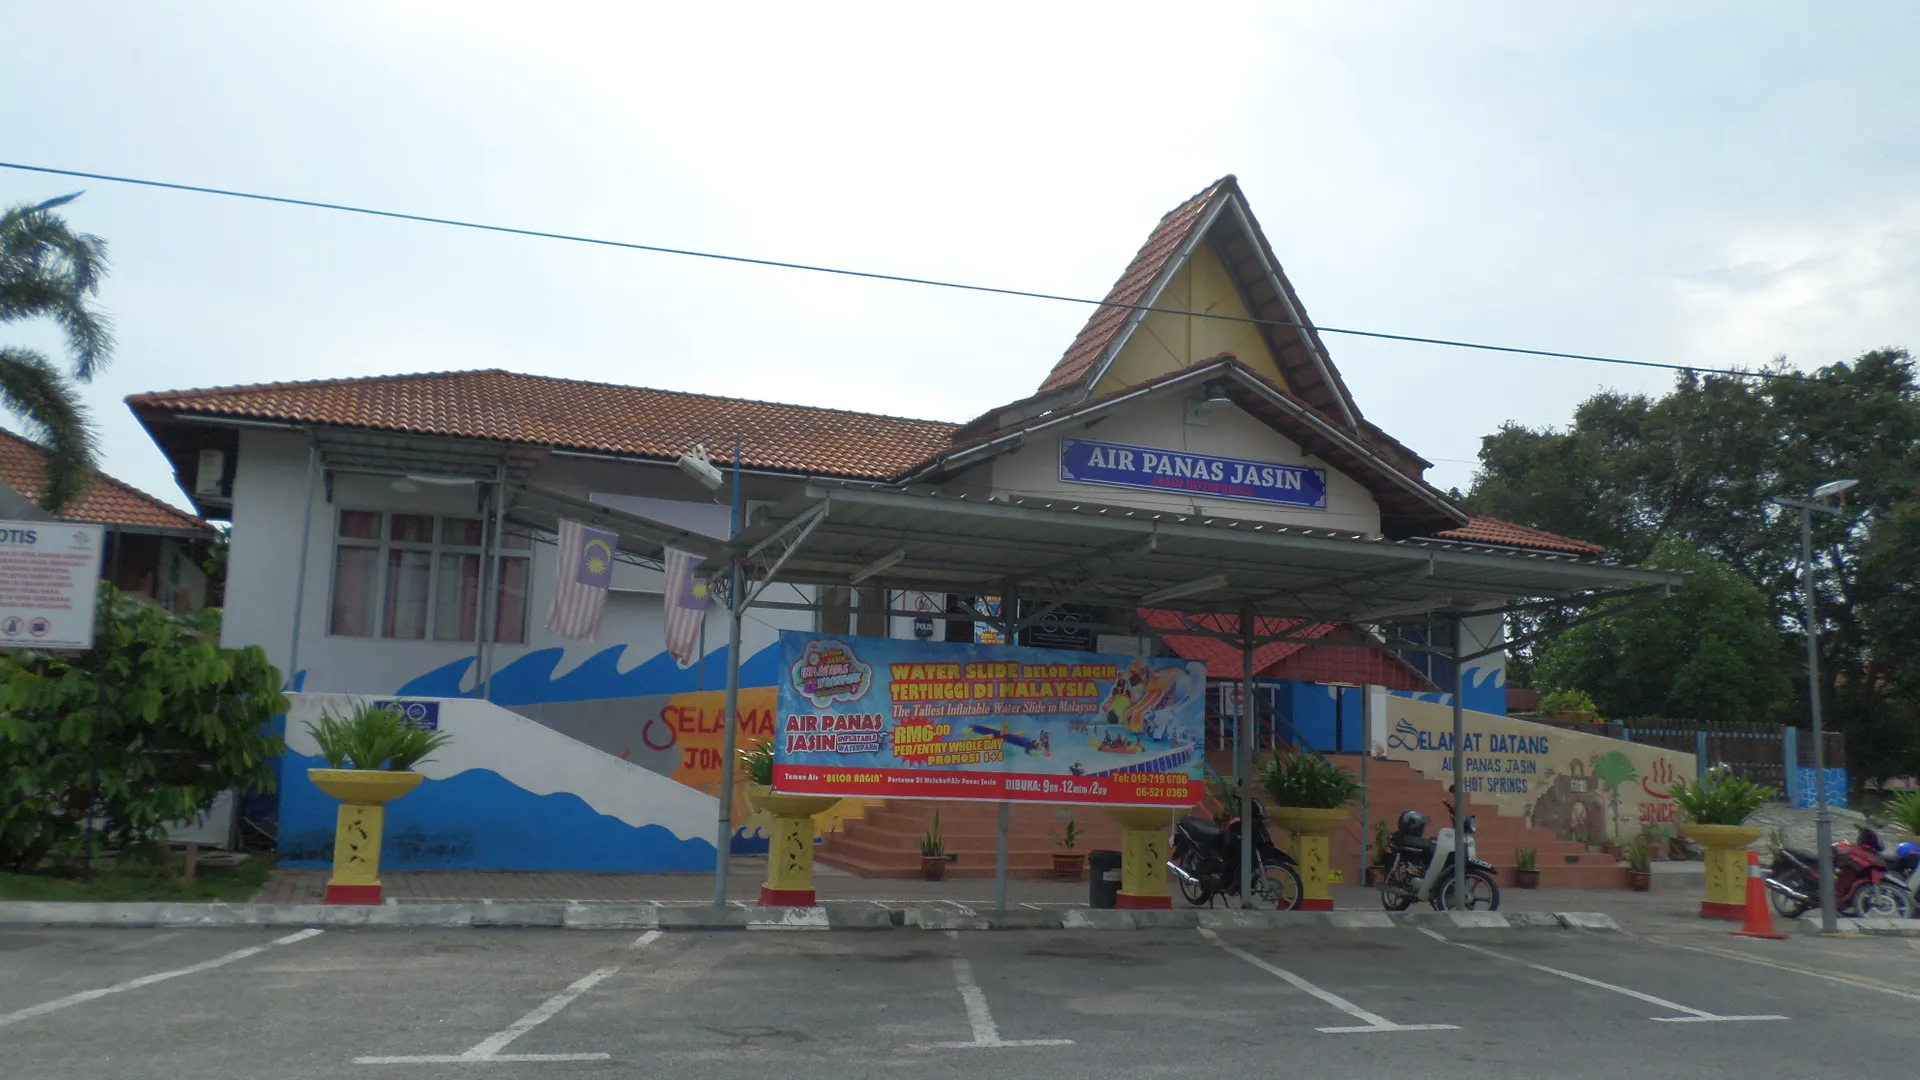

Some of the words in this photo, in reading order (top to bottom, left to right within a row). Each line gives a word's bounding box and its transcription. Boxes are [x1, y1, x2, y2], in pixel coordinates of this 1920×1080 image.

[1088, 447, 1135, 471] AIR
[1142, 453, 1224, 481] PANAS
[1230, 464, 1302, 490] JASIN
[916, 622, 932, 631] POLIS
[892, 665, 961, 680] WATER
[966, 664, 1019, 679] SLIDE
[1024, 666, 1068, 678] BELON
[1071, 665, 1116, 678] ANGIN
[891, 683, 969, 700] TERTINGGI
[974, 683, 994, 698] DI
[1000, 682, 1098, 698] MALAYSIA
[892, 704, 910, 717] The
[914, 704, 944, 716] Tallest
[947, 702, 990, 715] Inflatable
[994, 702, 1020, 714] Water
[1023, 701, 1046, 714] Slide
[1048, 702, 1057, 712] in
[1059, 700, 1098, 714] Malaysia
[786, 715, 818, 731] AIR
[822, 713, 883, 731] PANAS
[838, 734, 877, 743] INFLATABLE
[894, 724, 951, 743] RM6.00
[786, 734, 836, 754] JASIN
[838, 744, 879, 752] WATERPARK
[894, 743, 947, 756] PER/ENTRY
[949, 740, 982, 753] WHOLE
[984, 738, 1004, 750] DAY
[1490, 734, 1549, 755] DATANG
[928, 753, 978, 765] PROMOSI
[1466, 758, 1501, 773] PANAS
[1505, 759, 1537, 775] JASIN
[808, 773, 819, 781] Air
[1005, 779, 1041, 792] DIBUKA:
[1113, 773, 1129, 783] Tel:
[1131, 774, 1165, 784] 019-719
[1167, 775, 1188, 785] 6706
[1464, 777, 1483, 793] HOT
[1487, 777, 1529, 794] SPRINGS
[1136, 787, 1164, 797] 06-521
[1166, 787, 1188, 798] 0369
[1639, 803, 1675, 823] SINCE
